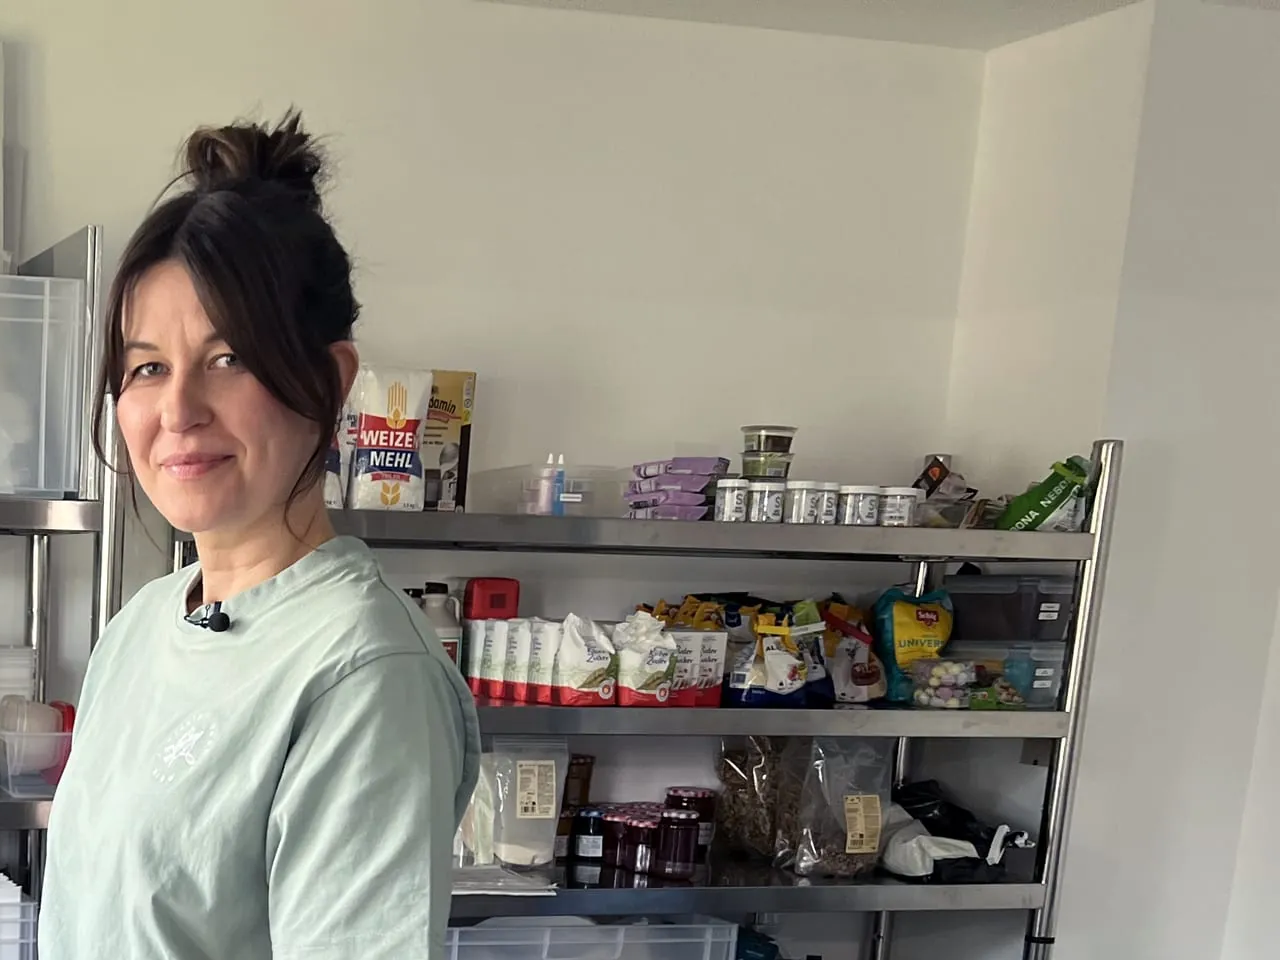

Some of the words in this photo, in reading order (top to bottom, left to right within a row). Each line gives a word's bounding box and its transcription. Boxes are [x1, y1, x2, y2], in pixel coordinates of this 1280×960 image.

[428, 395, 456, 414] damin
[361, 430, 418, 448] WEIZE
[370, 451, 413, 468] MEHL
